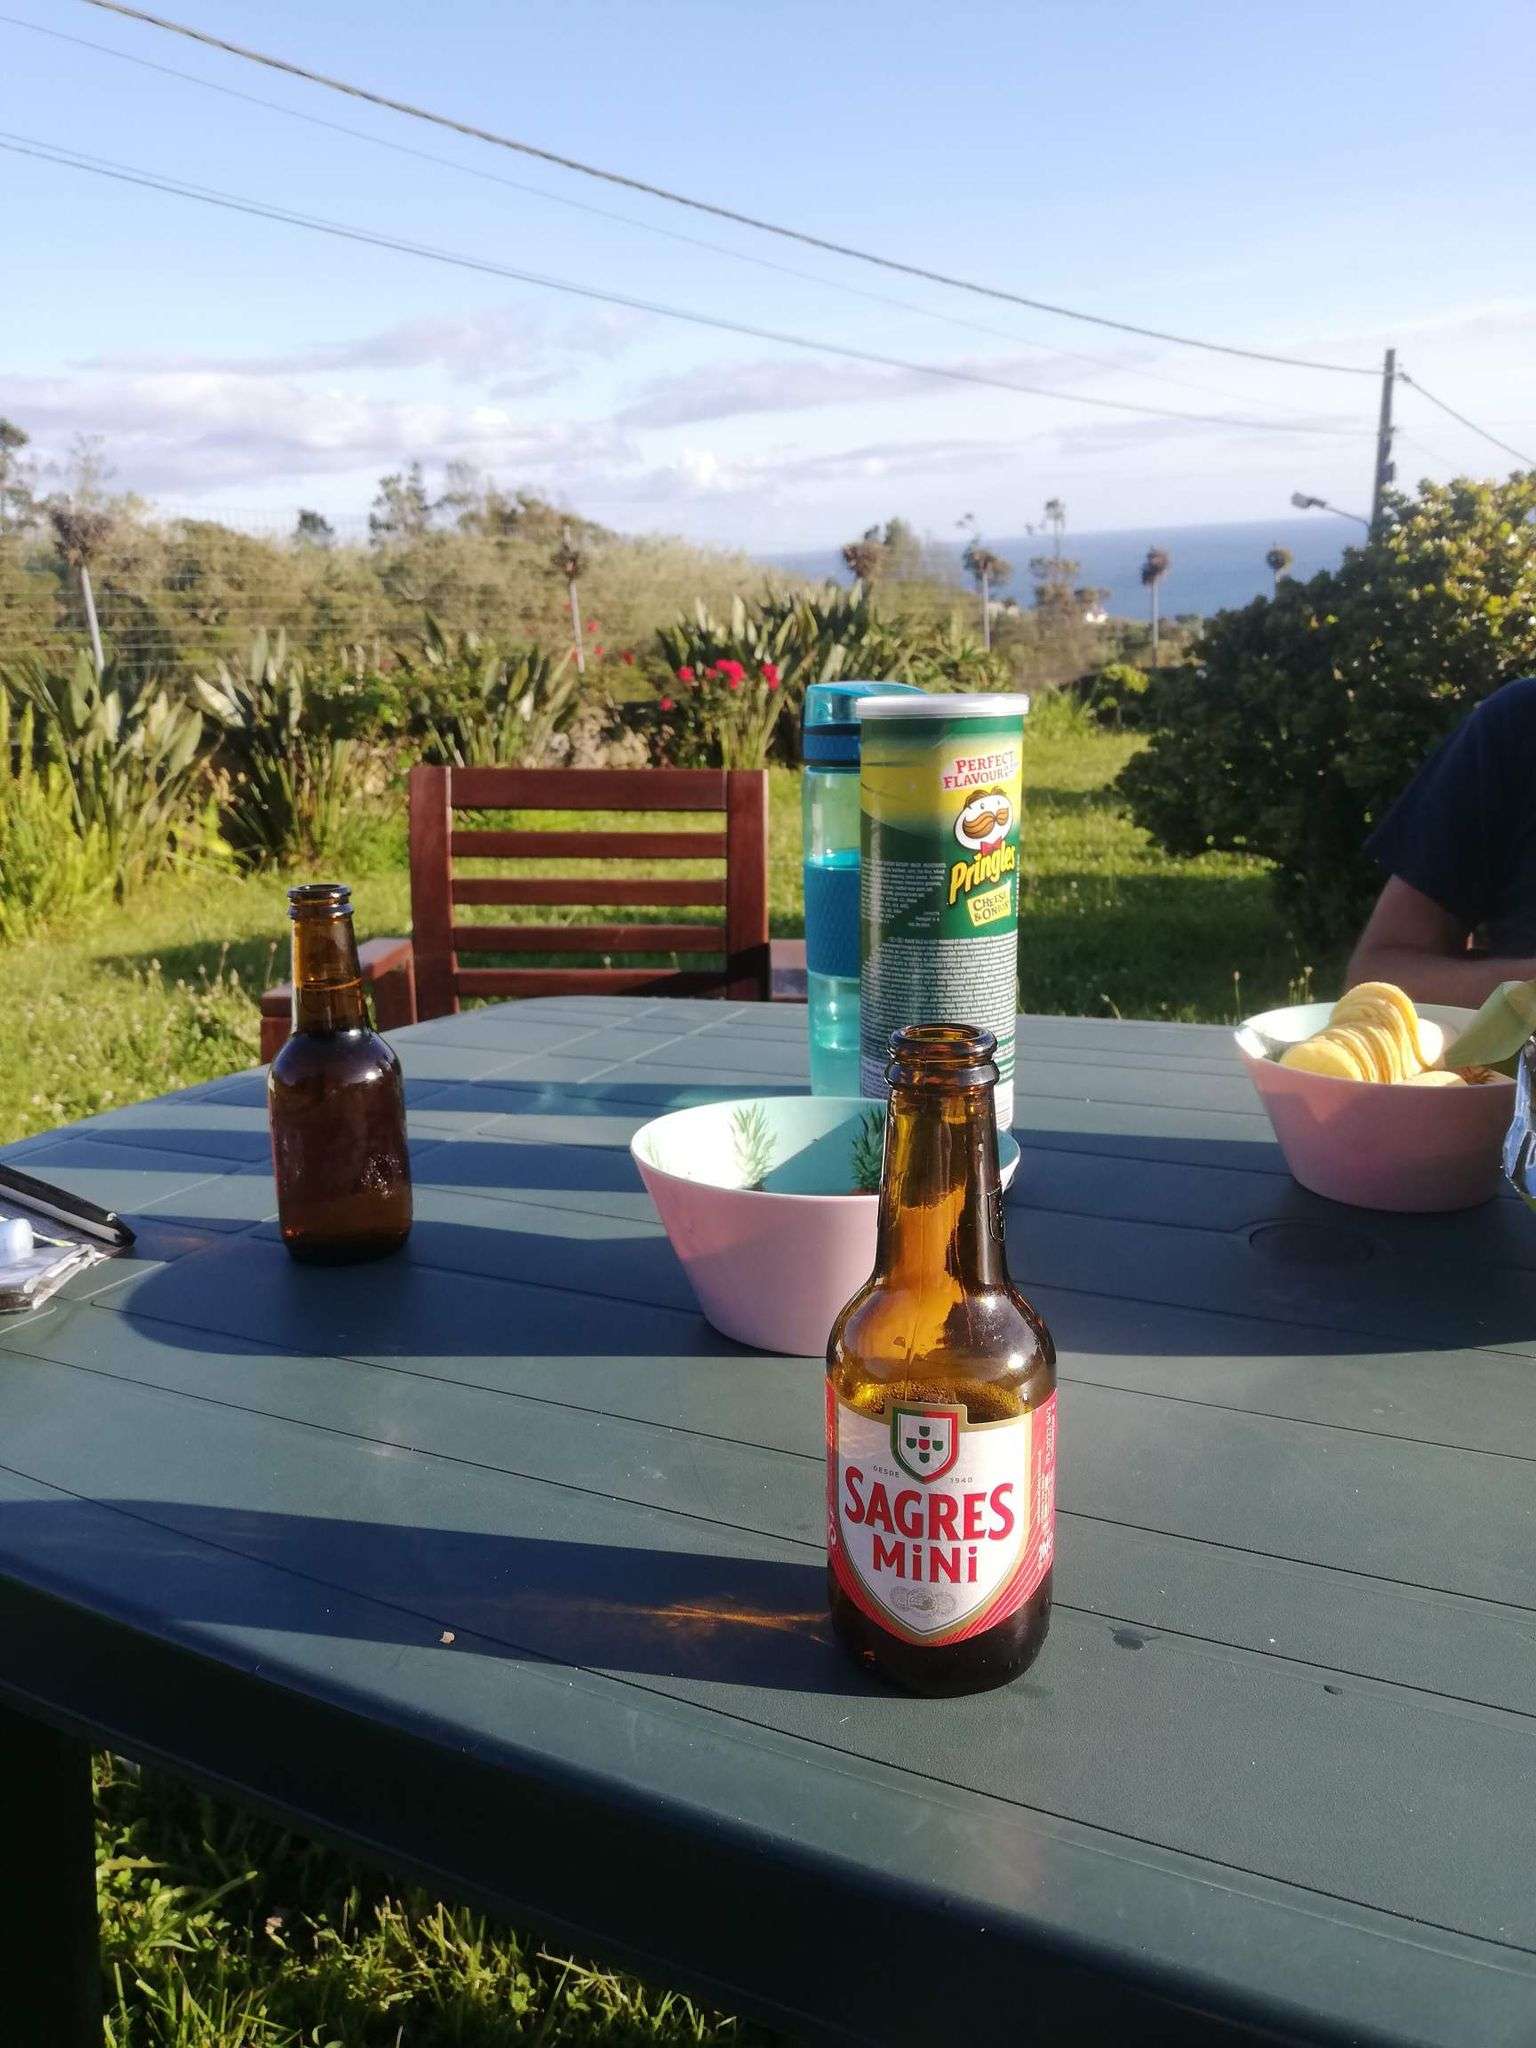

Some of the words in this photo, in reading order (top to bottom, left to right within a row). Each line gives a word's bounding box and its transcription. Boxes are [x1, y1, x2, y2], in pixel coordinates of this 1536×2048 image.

[955, 751, 1014, 774] PERFECT
[948, 839, 1016, 906] Pringles
[871, 1464, 900, 1478] DESDE
[844, 1466, 1015, 1541] SAGRES
